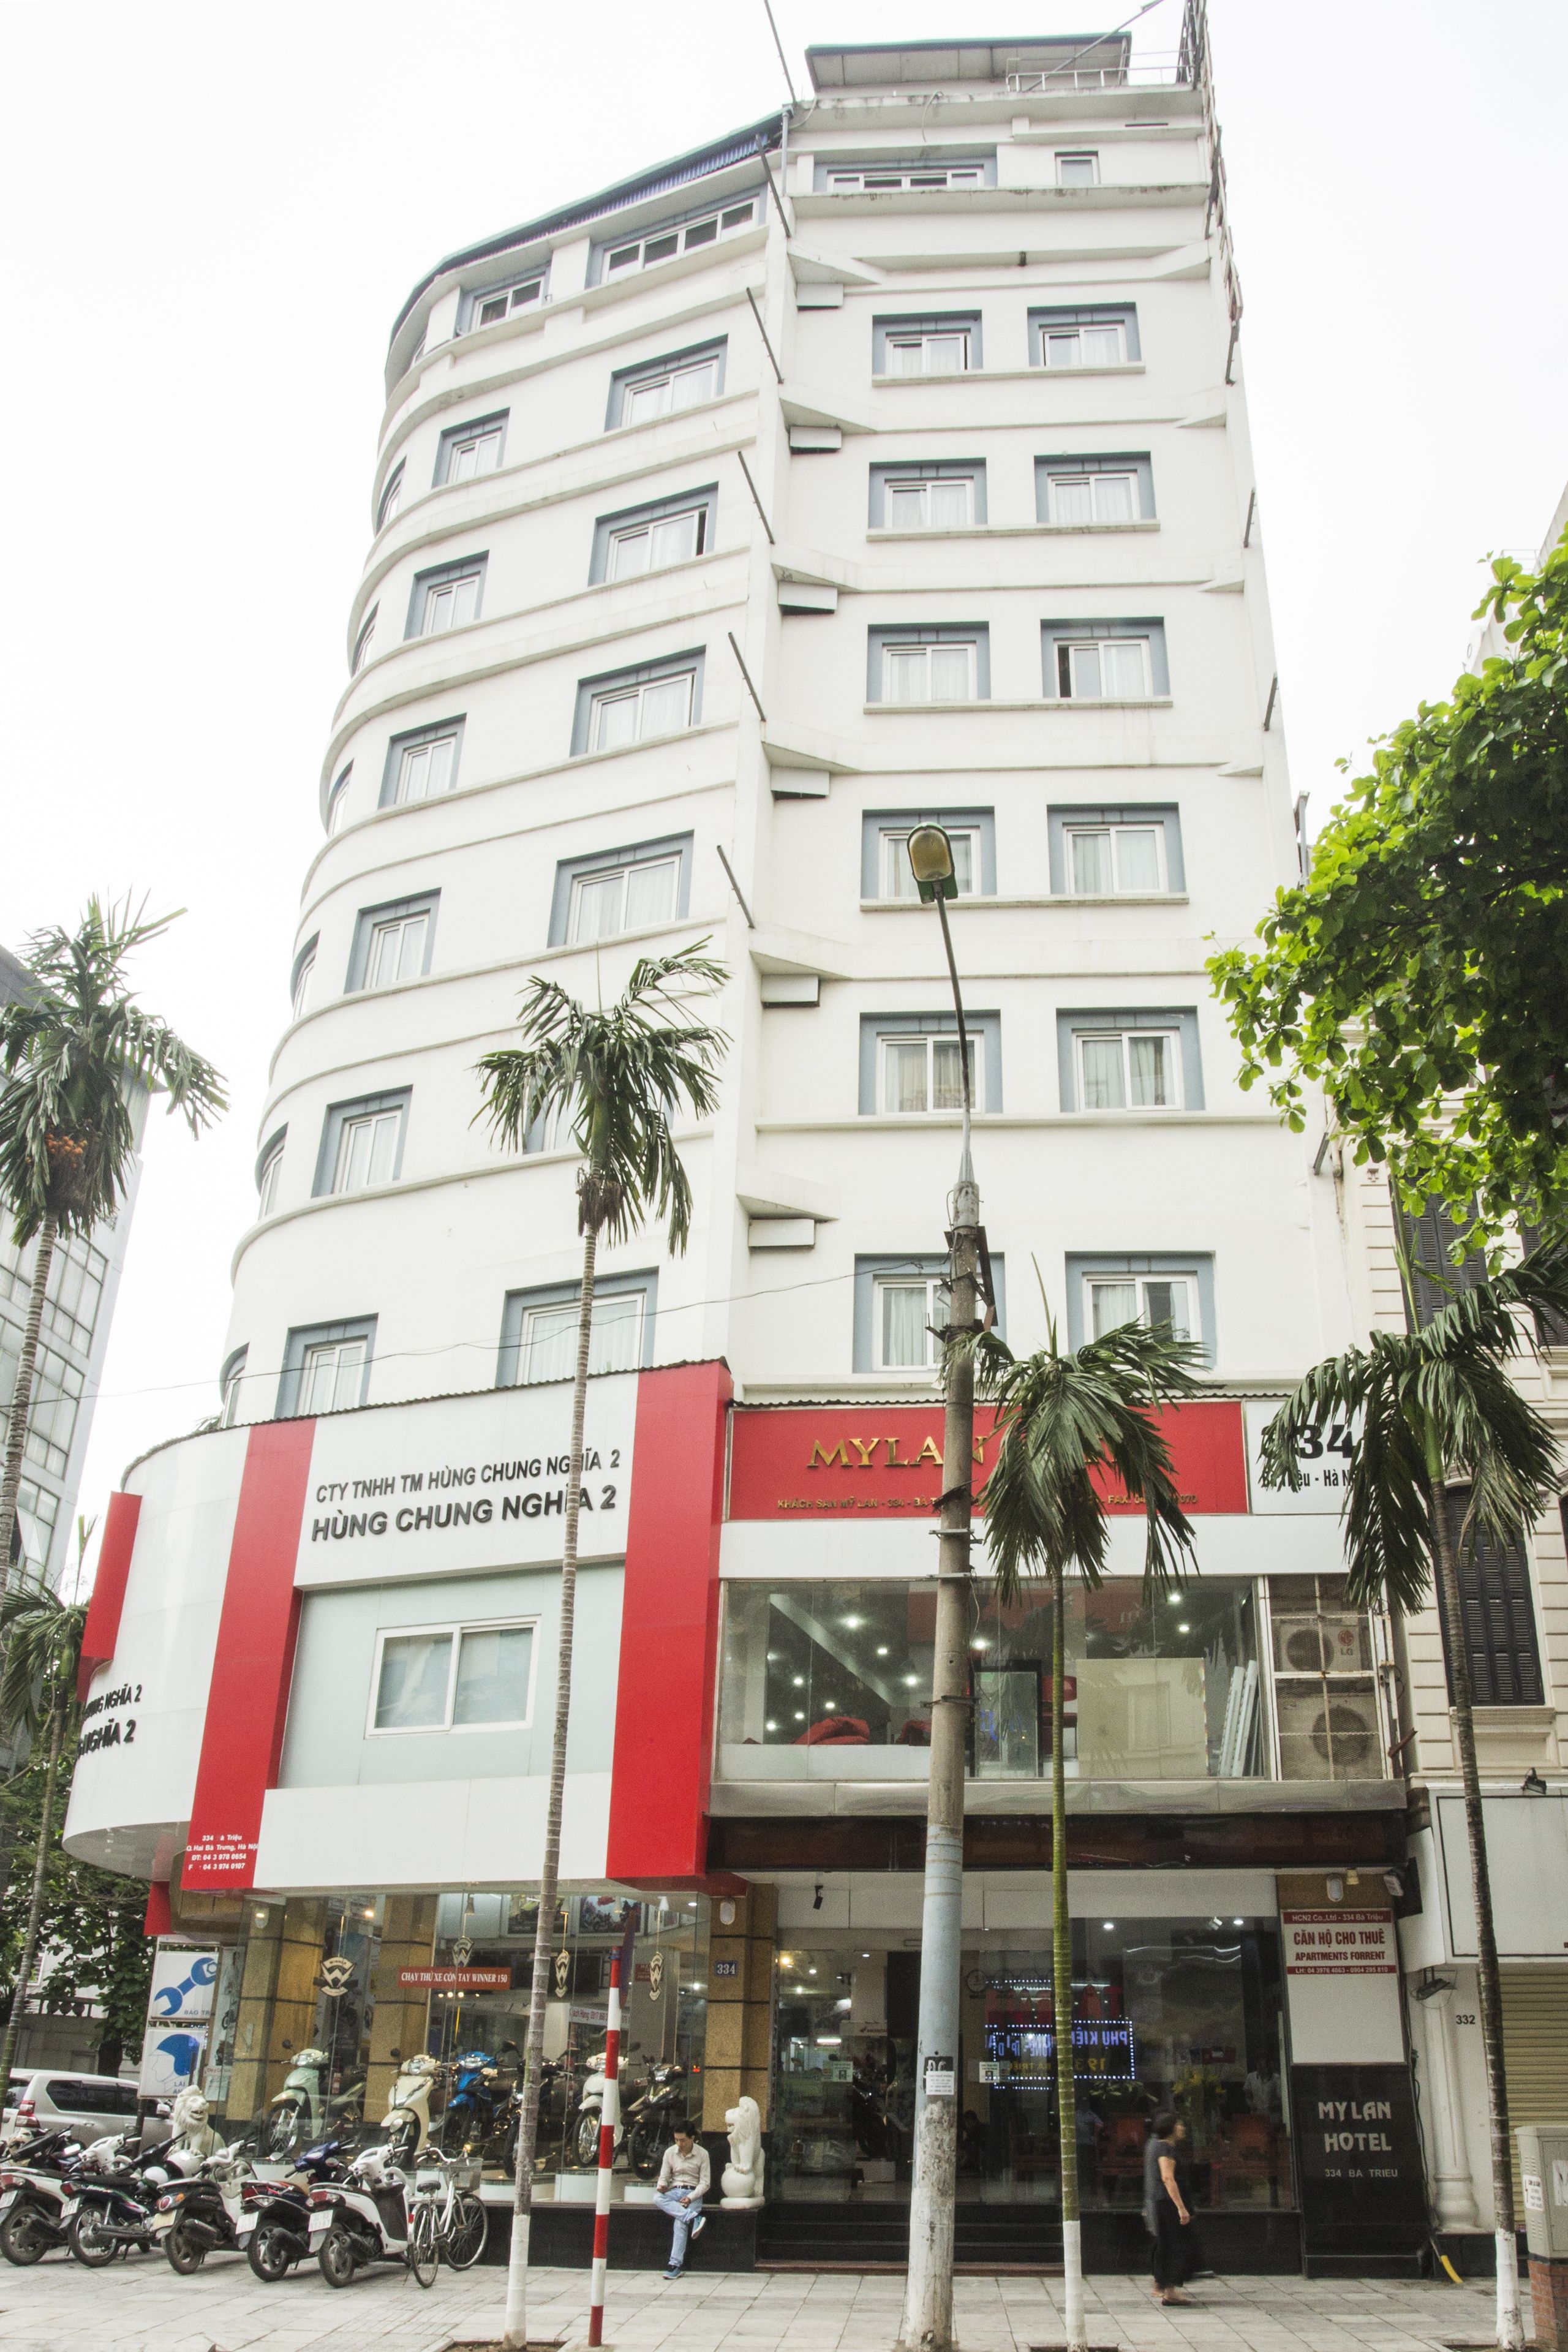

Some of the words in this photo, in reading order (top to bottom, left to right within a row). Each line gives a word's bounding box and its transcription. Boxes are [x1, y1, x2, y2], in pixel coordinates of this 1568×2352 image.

[316, 1482, 349, 1502] CTY
[352, 1476, 395, 1499] TNHH
[401, 1473, 423, 1493] TM
[428, 1465, 476, 1490] HÙNG
[481, 1459, 541, 1483] CHUNG
[610, 1449, 620, 1468] 2
[1323, 1469, 1339, 1487] Hà
[778, 1497, 813, 1509] KHÁCH
[816, 1499, 836, 1511] SẠN
[840, 1496, 855, 1509] MỸ
[858, 1499, 877, 1507] LAN
[888, 1499, 904, 1507] 334
[311, 1509, 387, 1542] HÙNG
[396, 1499, 493, 1532] CHUNG
[600, 1485, 616, 1509] 2
[1340, 1648, 1353, 1656] LG
[134, 1684, 142, 1702] 2
[123, 1719, 137, 1743] 2
[1294, 1929, 1315, 1945] CĂN
[1318, 1929, 1332, 1948] HỘ
[1335, 1931, 1356, 1945] CHO
[1359, 1928, 1385, 1945] THUÊ
[1295, 1951, 1348, 1961] APARTMENTS
[1350, 1951, 1385, 1960] FORRENT
[717, 1963, 736, 1975] 334
[401, 1972, 418, 1983] CHẠY
[434, 1973, 442, 1981] XE
[458, 1973, 470, 1982] TAY
[472, 1973, 496, 1983] WINNER
[497, 1974, 508, 1983] 150
[1456, 2015, 1476, 2024] 332
[1324, 2132, 1392, 2153] HOTEL
[1324, 2169, 1341, 2177] 334
[1349, 2169, 1363, 2177] BA
[1368, 2169, 1398, 2177] TRIEU
